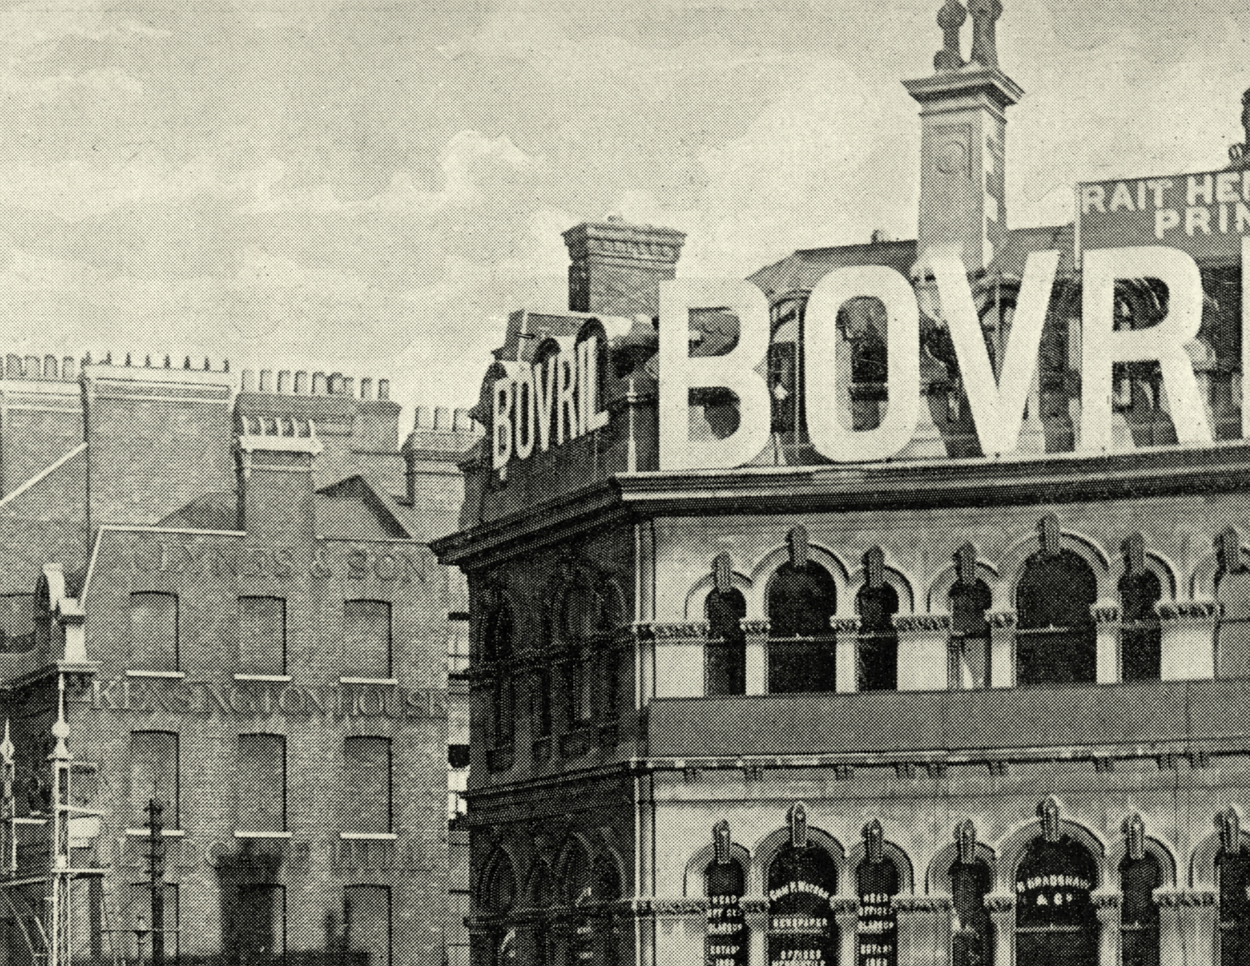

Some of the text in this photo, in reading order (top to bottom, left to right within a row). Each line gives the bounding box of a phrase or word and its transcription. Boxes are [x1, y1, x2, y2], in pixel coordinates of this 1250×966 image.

[1082, 170, 1250, 214] RAIT HE
[658, 244, 1250, 471] BOVR
[492, 336, 610, 470] BOVRIL
[347, 548, 427, 584] SON
[91, 679, 327, 716] KENSINGTON
